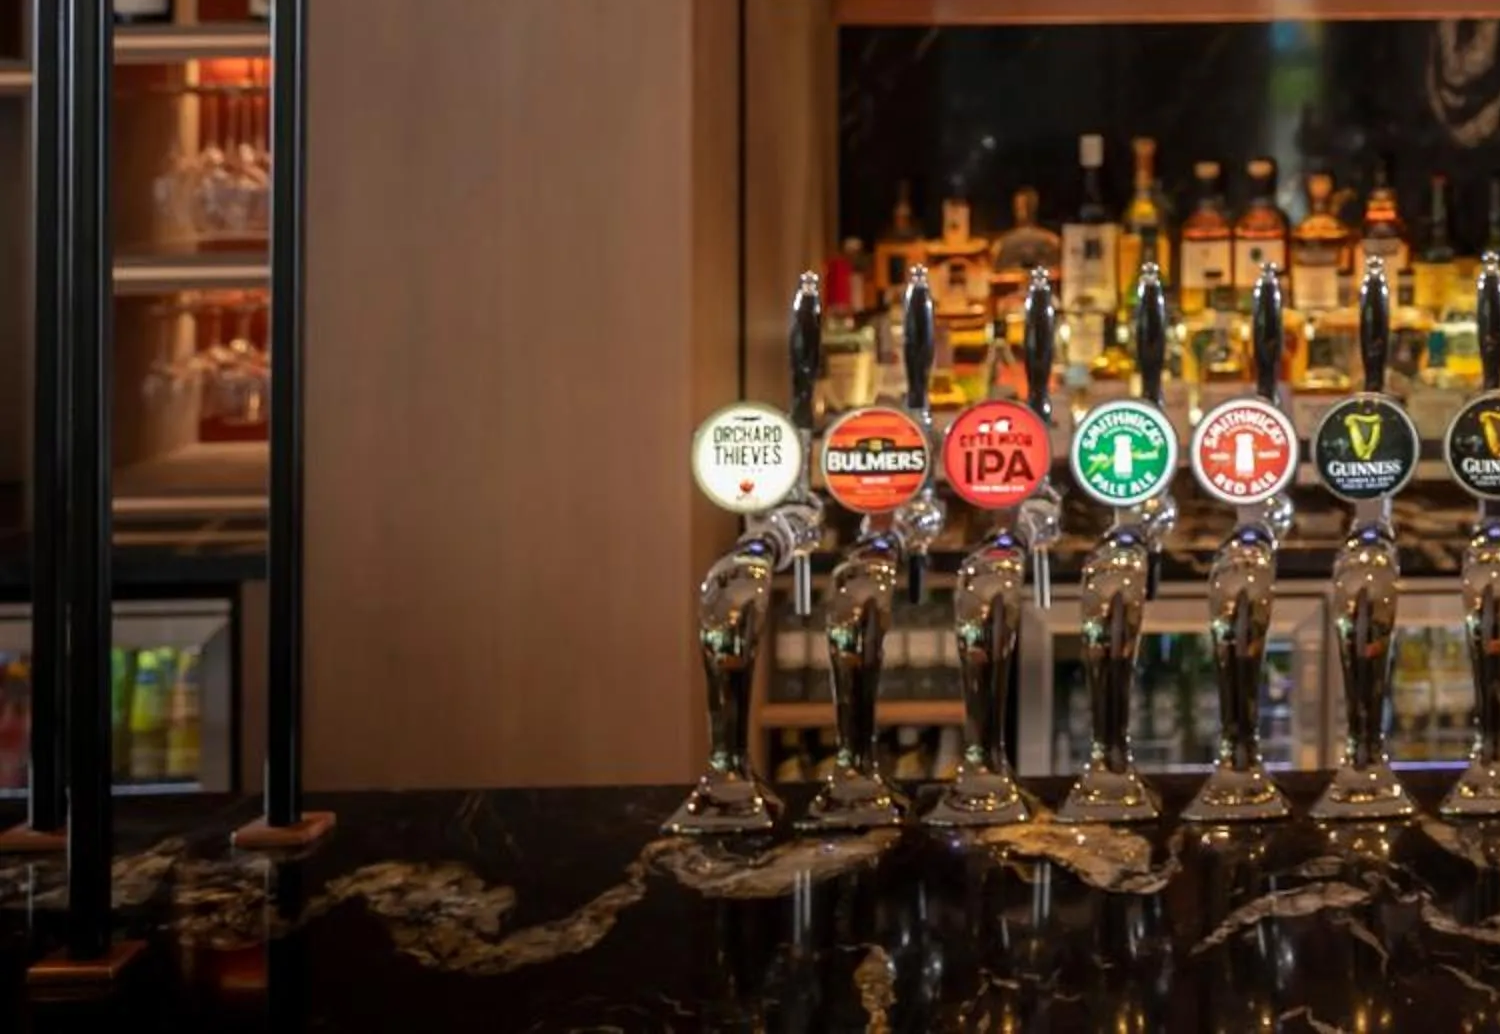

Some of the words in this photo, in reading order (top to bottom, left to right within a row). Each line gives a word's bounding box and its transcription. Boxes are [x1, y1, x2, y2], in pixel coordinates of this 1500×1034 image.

[713, 425, 783, 445] ORCHARD
[714, 445, 783, 467] THIEVES
[826, 448, 925, 473] BULMERS
[965, 448, 1036, 485] IPA
[1327, 457, 1403, 477] GUINNESS
[1090, 472, 1127, 497] PALE
[1130, 470, 1157, 496] ALE
[1212, 472, 1247, 495] RED
[1249, 470, 1278, 495] ALE
